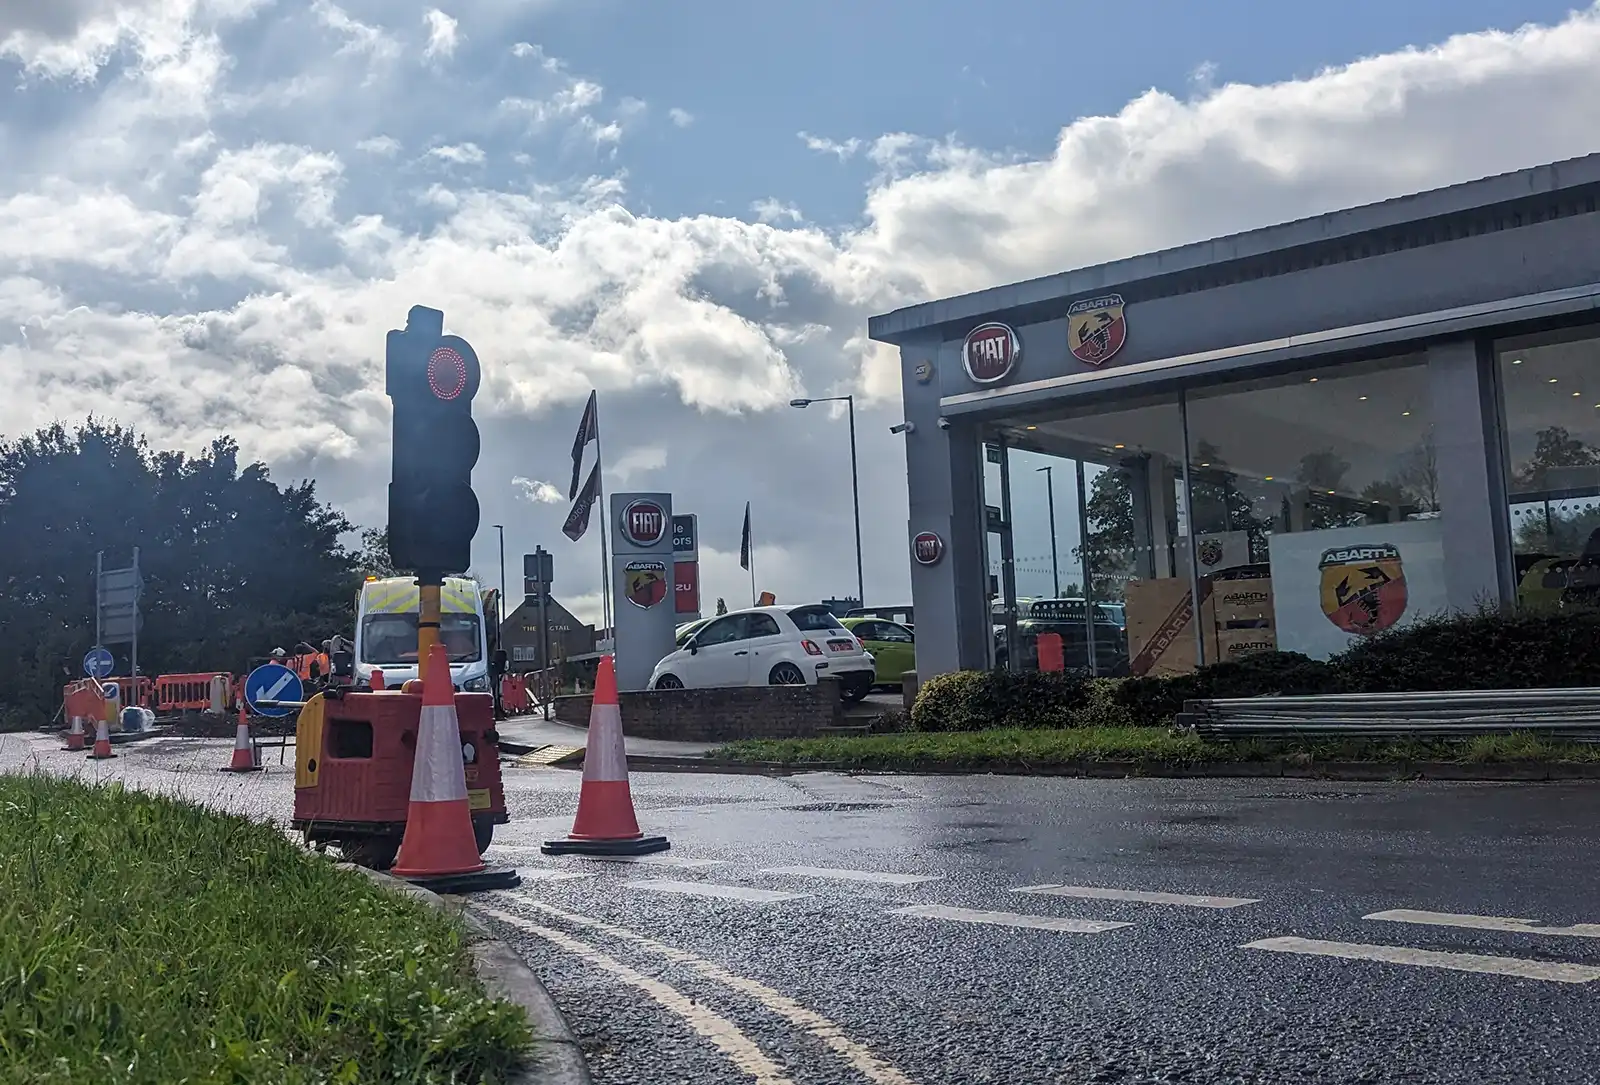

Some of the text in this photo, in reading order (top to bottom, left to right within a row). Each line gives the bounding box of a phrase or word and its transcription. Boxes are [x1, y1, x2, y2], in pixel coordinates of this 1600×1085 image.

[1070, 297, 1120, 313] ABARTH
[972, 336, 1006, 369] FIAT
[632, 512, 660, 534] FIAT
[673, 522, 683, 533] le
[672, 536, 692, 546] ors
[917, 540, 936, 557] FIAT
[1324, 549, 1396, 562] ABARTH
[1150, 604, 1194, 661] ABART
[1229, 642, 1273, 650] ABARTH
